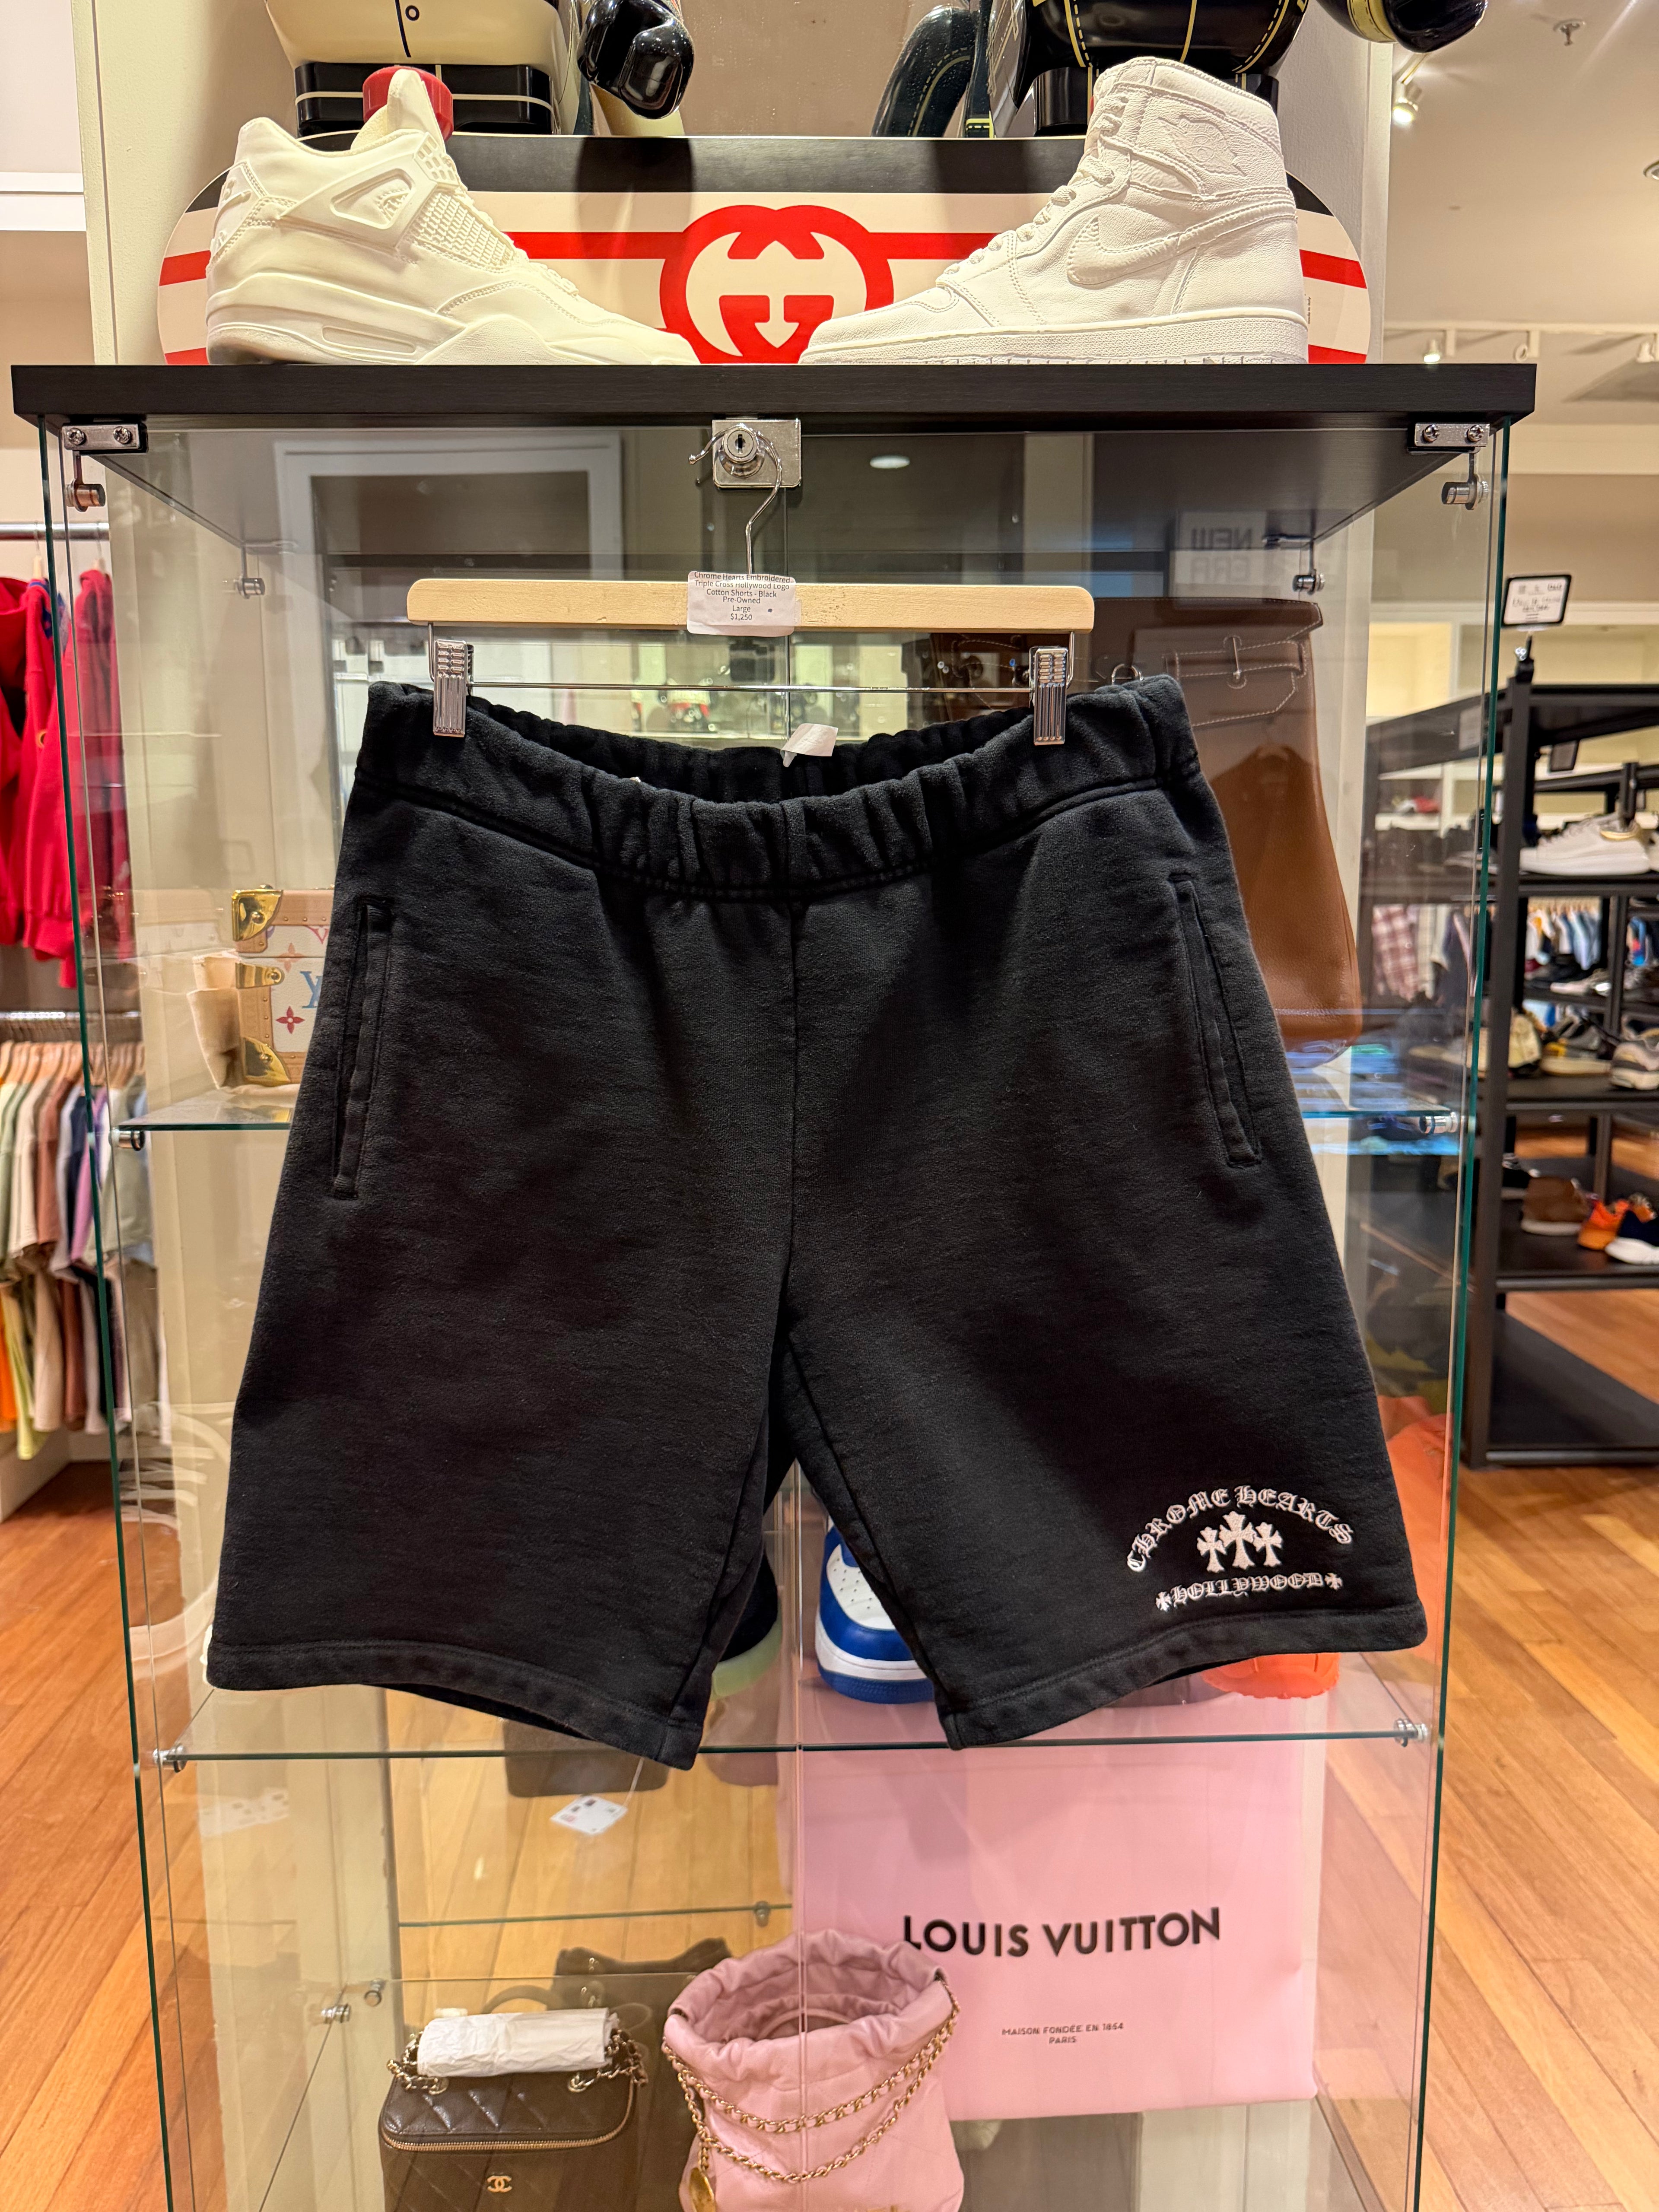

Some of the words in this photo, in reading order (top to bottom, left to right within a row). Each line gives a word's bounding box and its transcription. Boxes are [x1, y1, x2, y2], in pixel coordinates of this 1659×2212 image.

[746, 574, 790, 583] Embroidered
[732, 605, 751, 613] Large
[1127, 1488, 1231, 1573] CHROME
[1234, 1484, 1354, 1545] HEARTS
[1170, 1571, 1325, 1608] HOLLYWOOD
[903, 1915, 1029, 1957] LOUIS
[1042, 1906, 1220, 1957] VUITTON
[1001, 2027, 1040, 2036] MAISON
[1043, 2024, 1083, 2034] FONDÉE
[1049, 2036, 1077, 2044] PARIS
